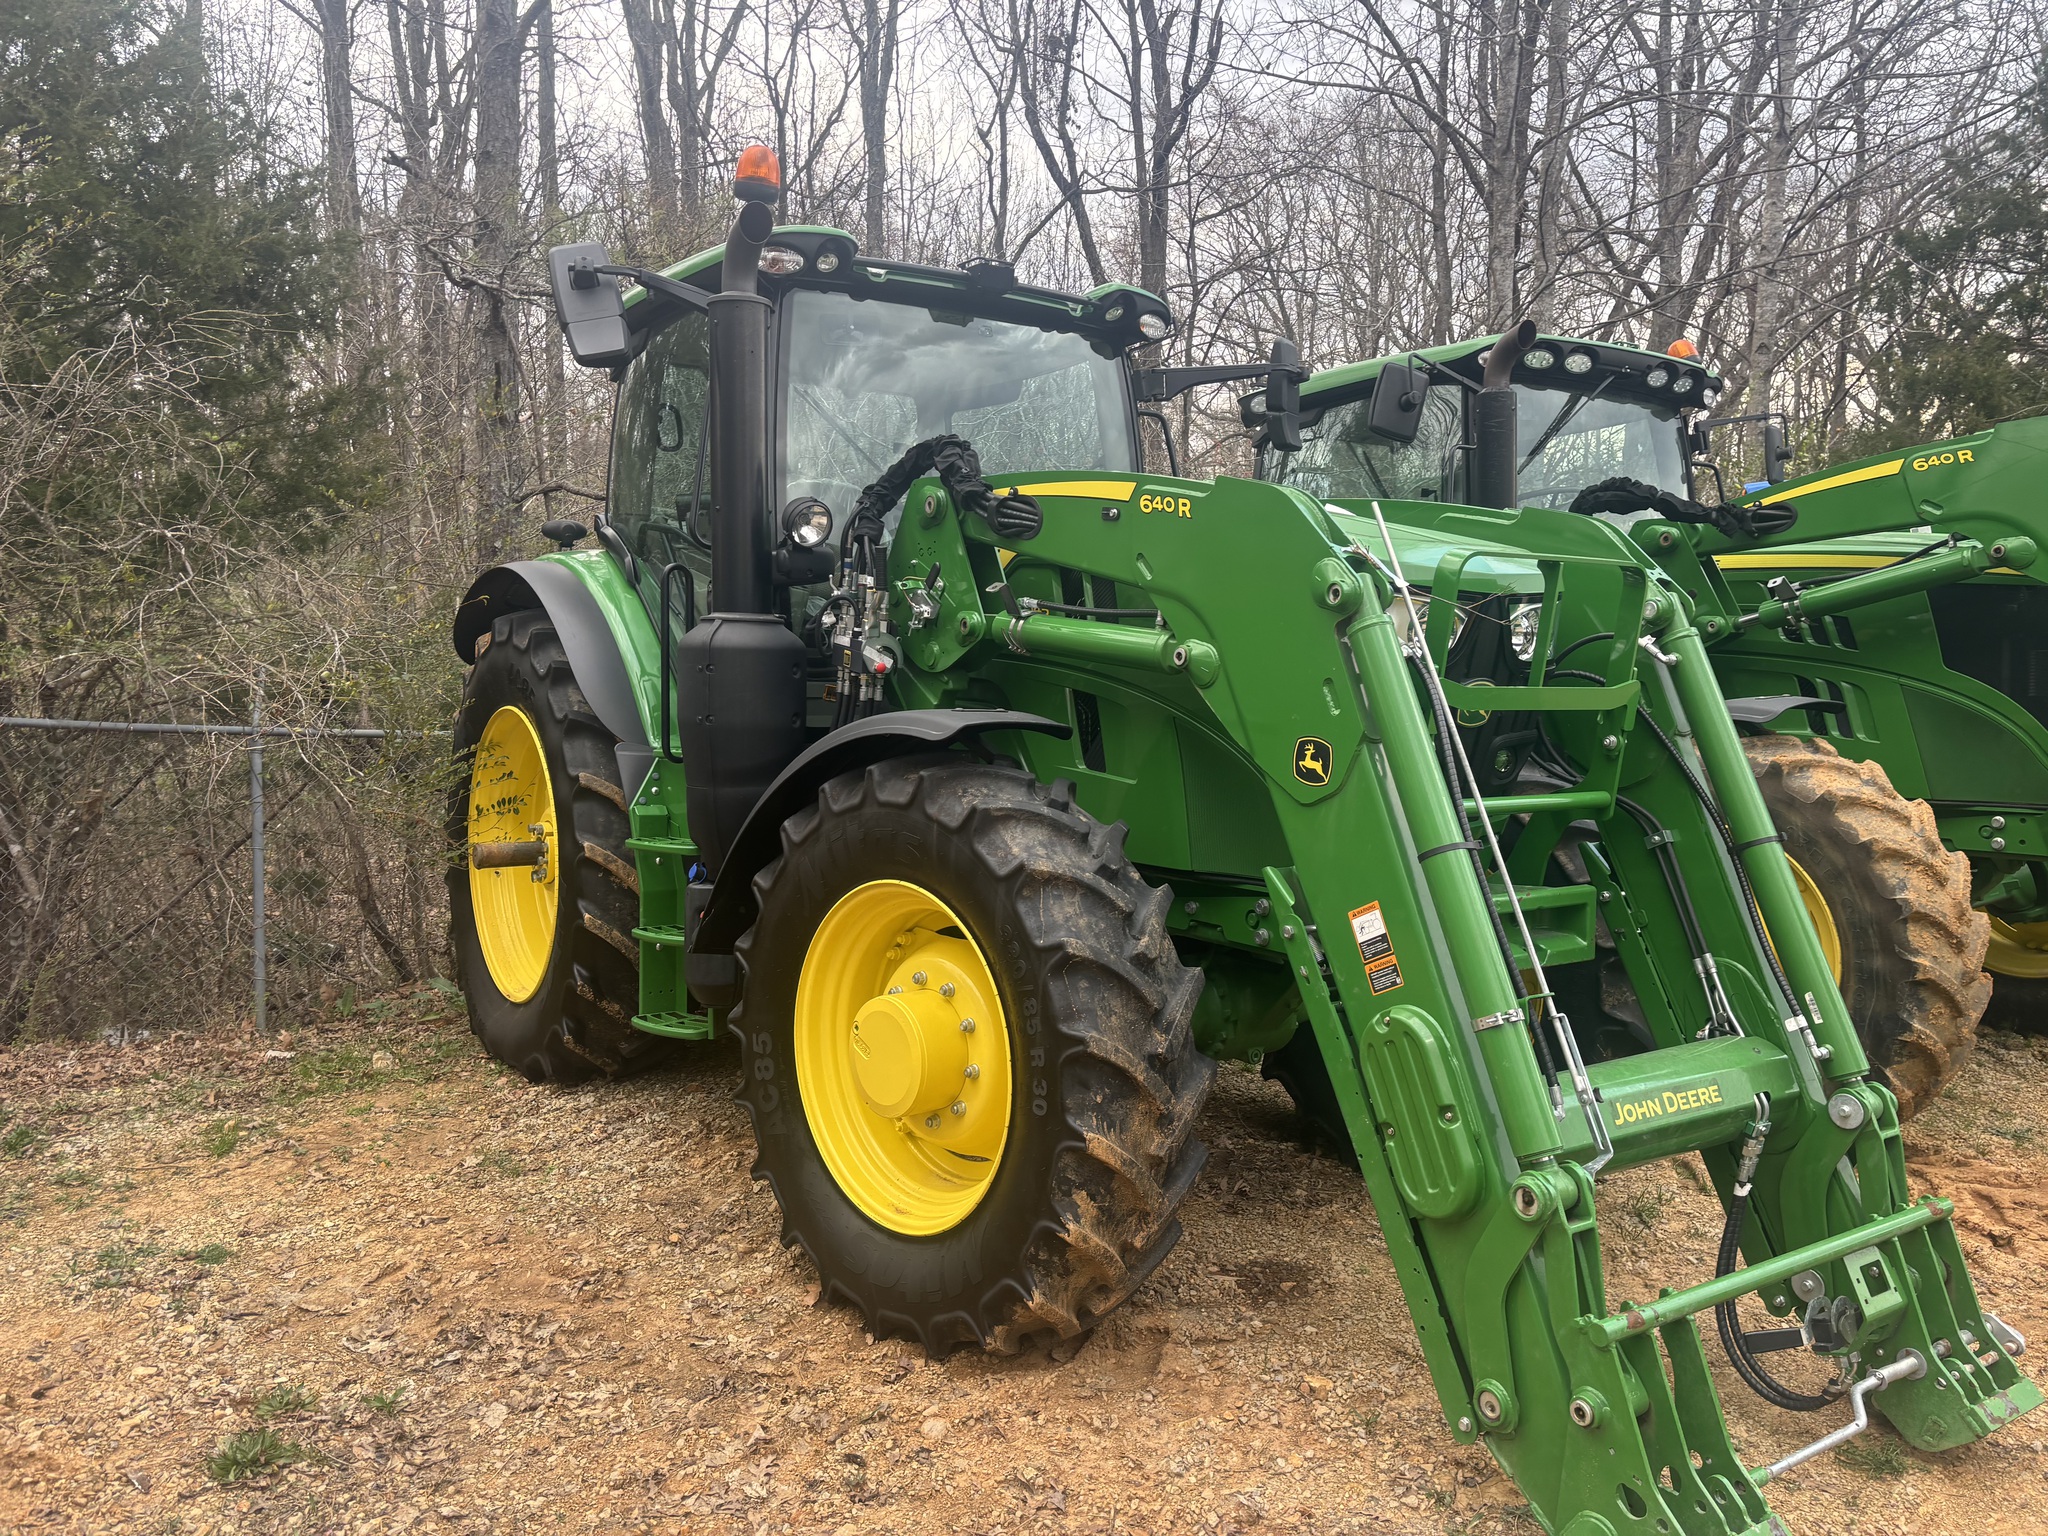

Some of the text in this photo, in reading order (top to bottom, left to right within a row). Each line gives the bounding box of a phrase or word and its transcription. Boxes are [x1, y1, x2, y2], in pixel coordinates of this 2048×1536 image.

[1356, 904, 1376, 915] WARNING
[1373, 958, 1394, 970] WARNING
[1614, 1085, 1722, 1126] JOHN DEERE
